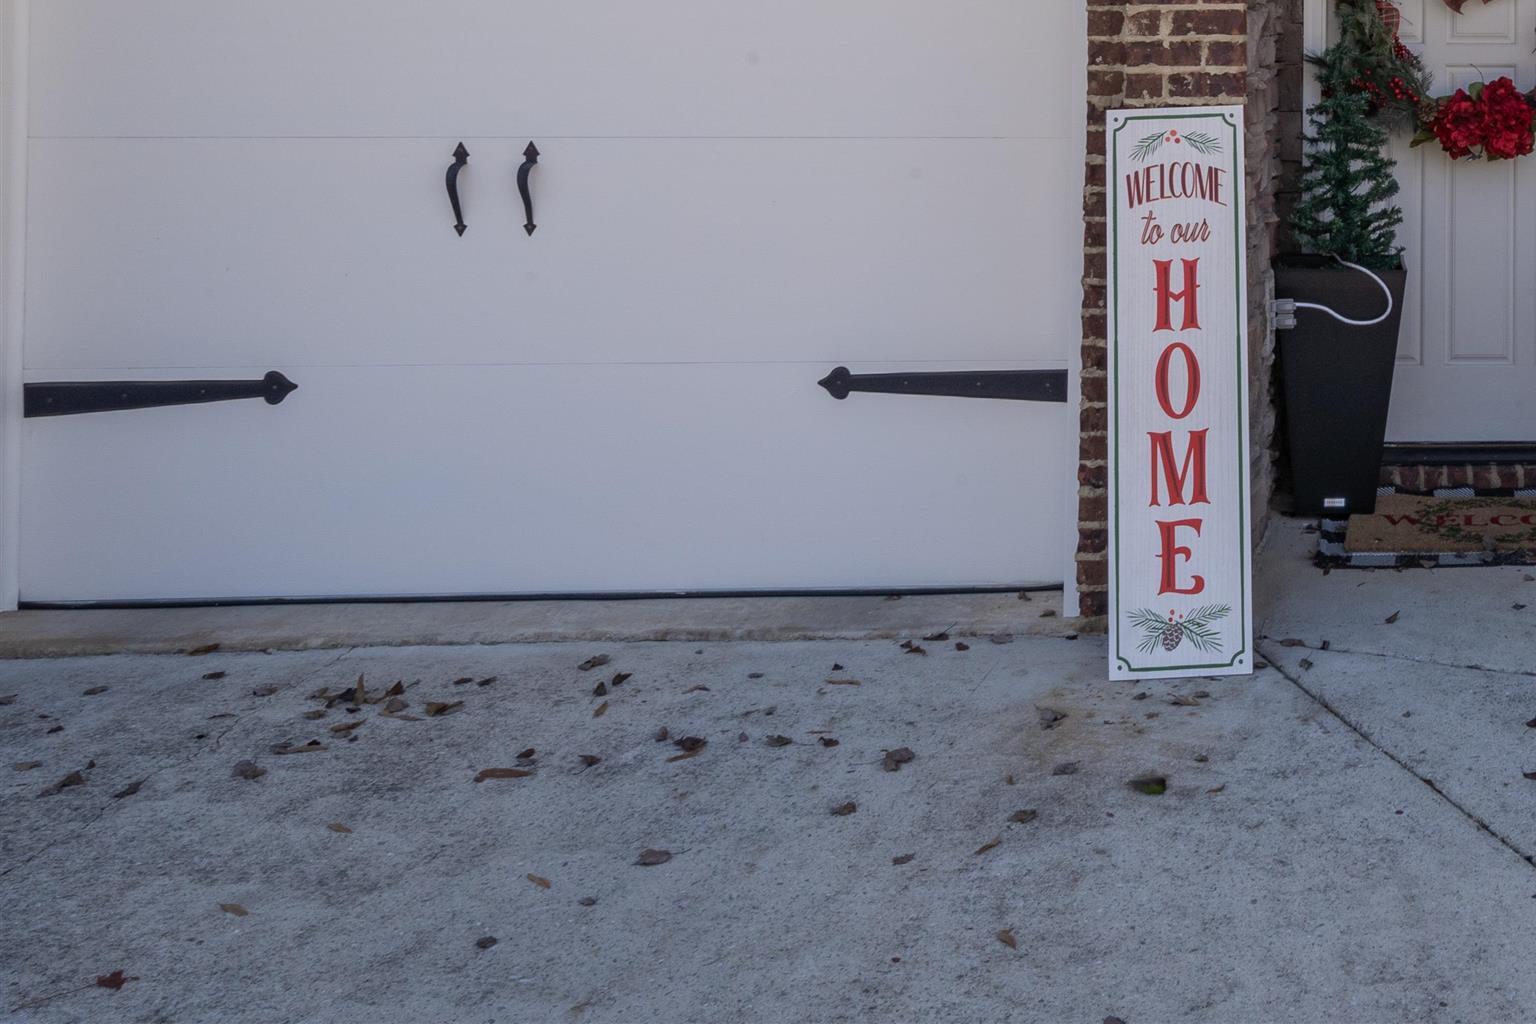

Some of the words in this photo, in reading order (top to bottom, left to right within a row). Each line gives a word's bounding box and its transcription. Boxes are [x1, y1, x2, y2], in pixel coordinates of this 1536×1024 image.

[1126, 161, 1228, 209] WELCOME
[1140, 210, 1165, 245] to
[1170, 218, 1211, 244] our
[1146, 257, 1211, 596] HOME
